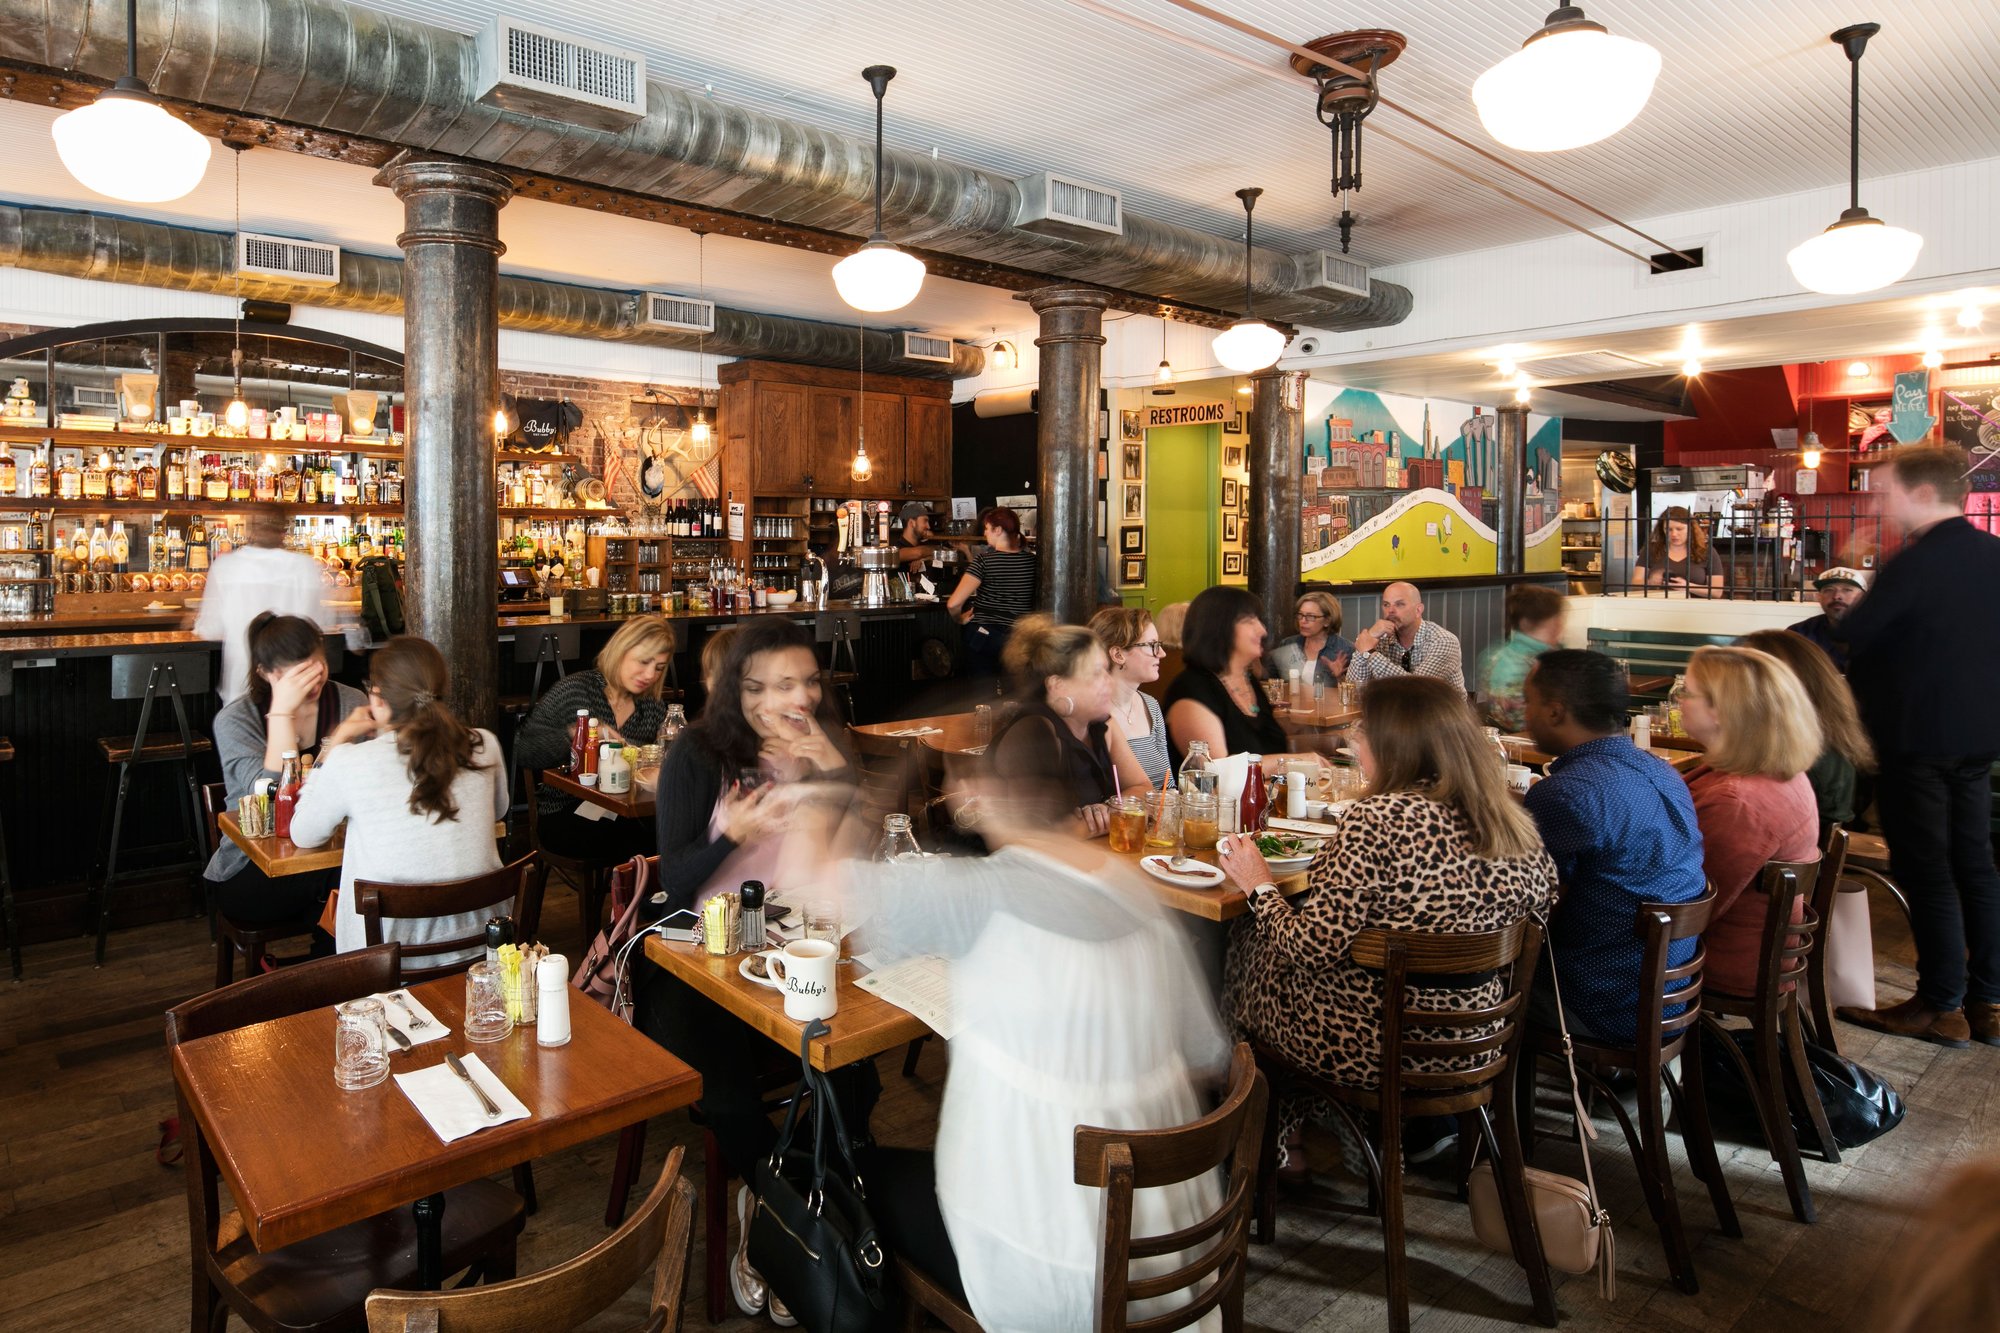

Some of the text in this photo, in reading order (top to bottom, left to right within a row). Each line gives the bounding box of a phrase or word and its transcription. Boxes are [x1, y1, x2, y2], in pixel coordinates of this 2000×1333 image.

[1895, 384, 1927, 404] Pay
[1150, 403, 1224, 425] RESTROOMS
[1894, 402, 1926, 412] HERE!
[786, 976, 827, 997] Bubby's
